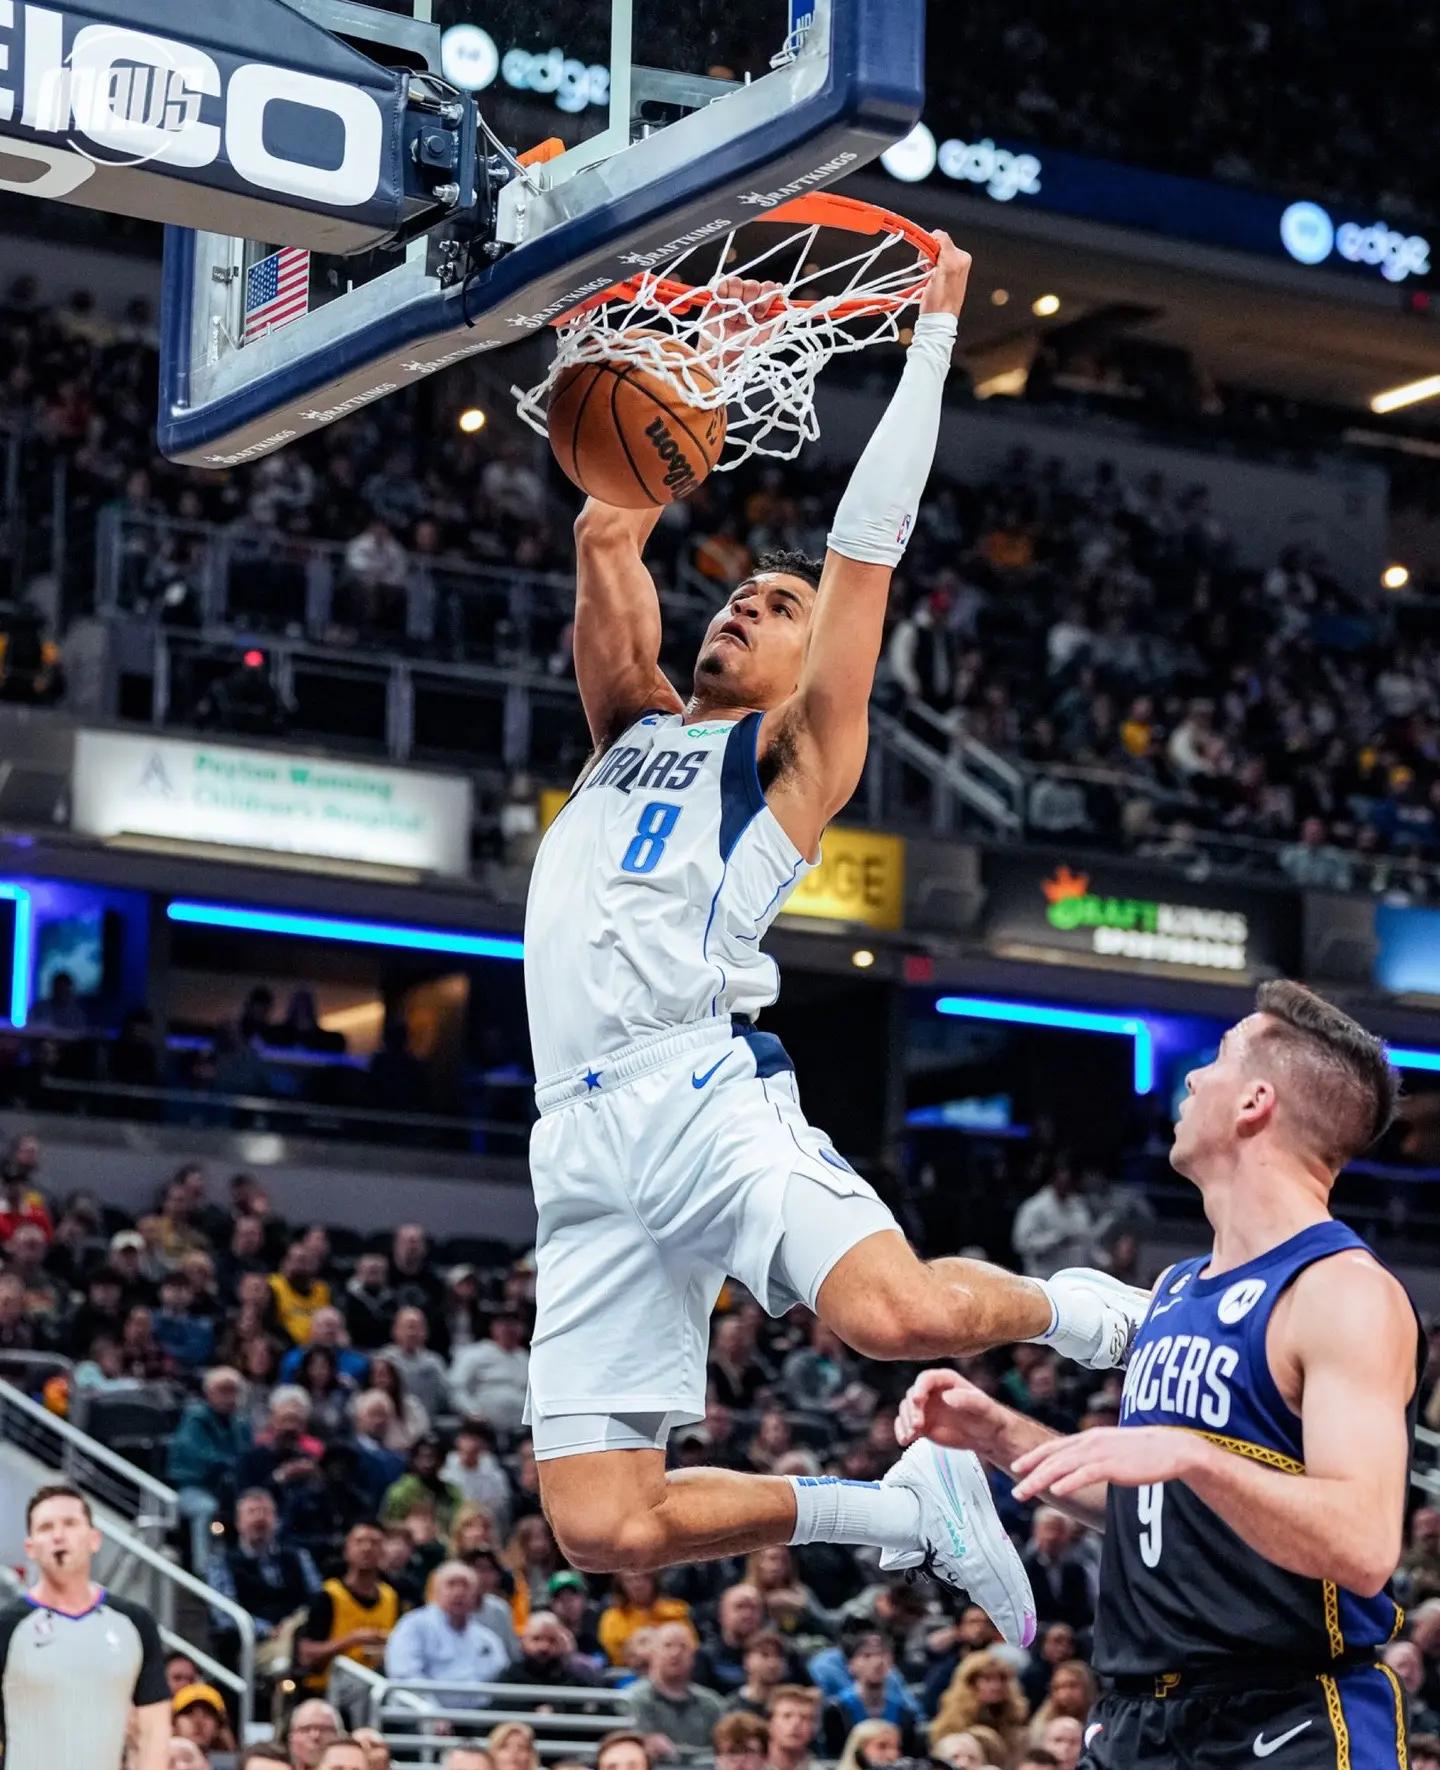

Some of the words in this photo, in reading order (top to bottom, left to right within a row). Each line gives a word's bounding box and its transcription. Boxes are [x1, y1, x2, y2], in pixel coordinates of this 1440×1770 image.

[502, 46, 609, 113] edge
[756, 151, 858, 208] DRAFTKINGS
[938, 138, 1042, 201] edge
[636, 218, 733, 267] DRAFTKINGS
[1336, 221, 1431, 283] edge
[523, 277, 614, 329] DRAFTKINGS
[317, 382, 397, 421] DRAFTKINGS
[222, 429, 296, 464] DRAFTKINGS
[585, 745, 713, 796] DALAS
[619, 800, 683, 874] 8
